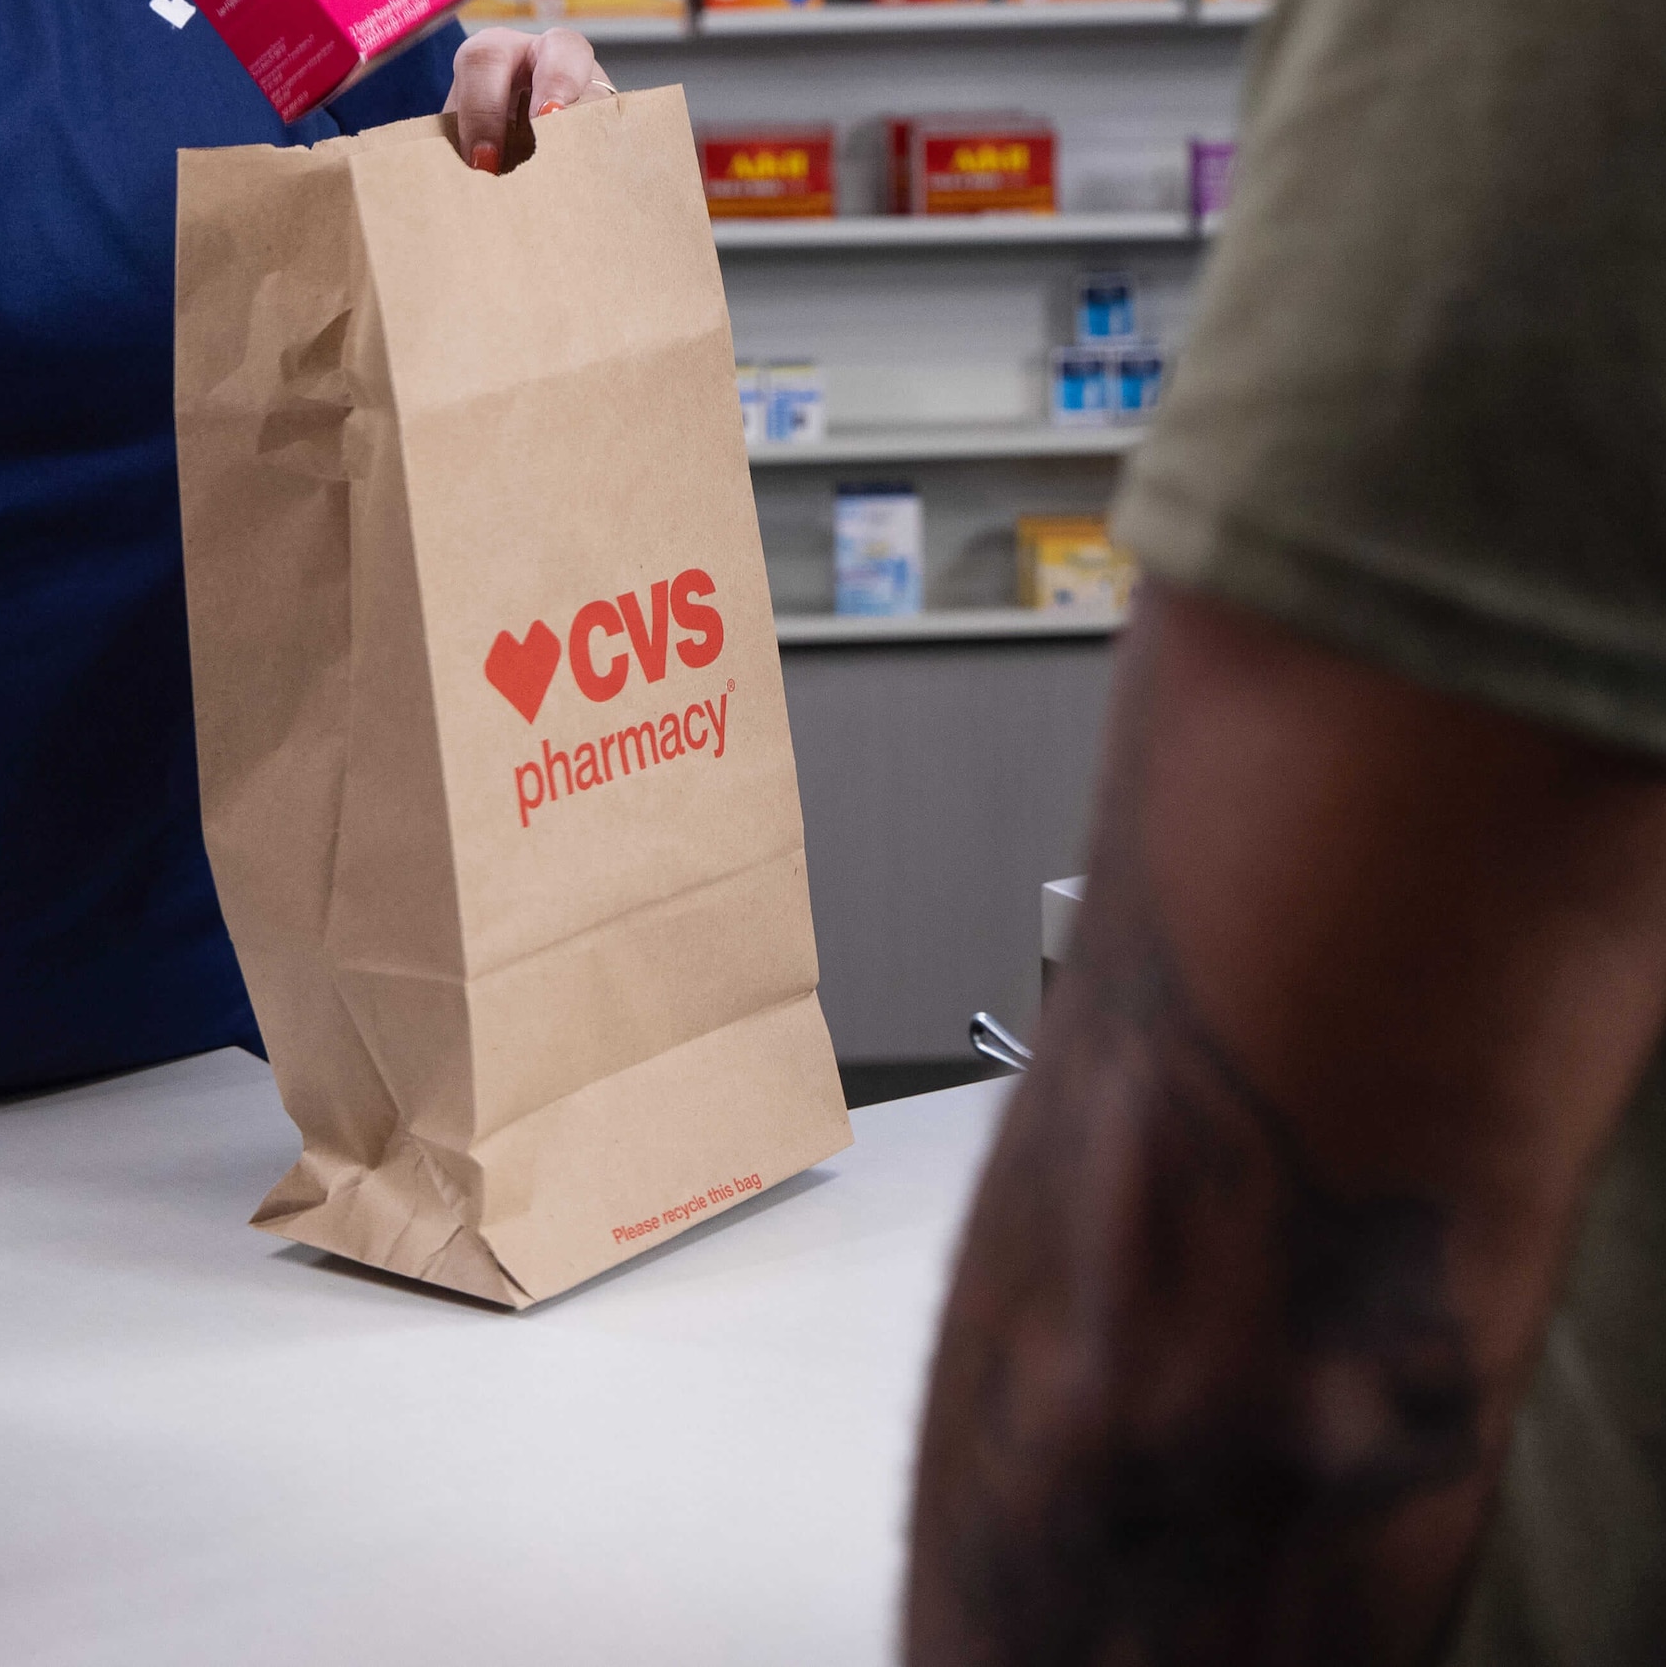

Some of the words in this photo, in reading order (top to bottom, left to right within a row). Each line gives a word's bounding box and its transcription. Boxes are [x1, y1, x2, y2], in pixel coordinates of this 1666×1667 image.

[569, 568, 724, 702] CVS
[514, 693, 727, 828] pharmacy
[612, 1216, 661, 1244] Please
[662, 1195, 707, 1225] recycle
[708, 1183, 733, 1205] this
[733, 1173, 762, 1193] bag
